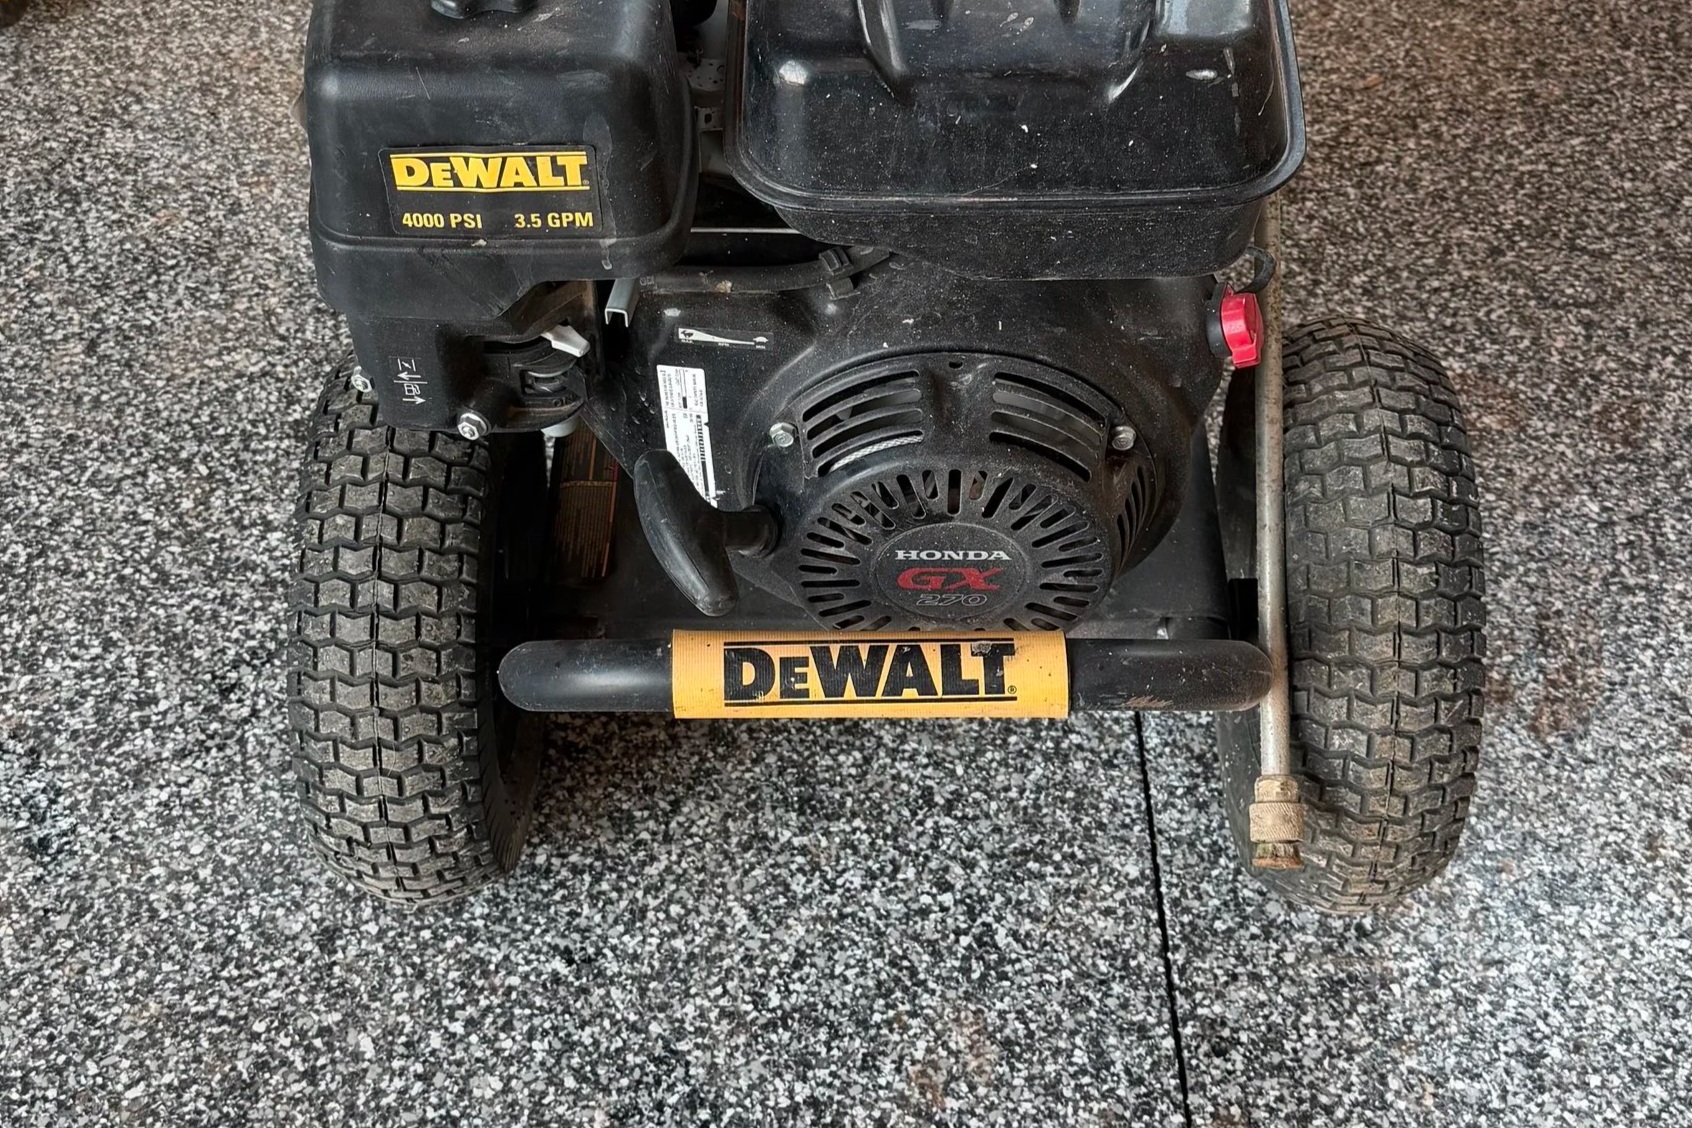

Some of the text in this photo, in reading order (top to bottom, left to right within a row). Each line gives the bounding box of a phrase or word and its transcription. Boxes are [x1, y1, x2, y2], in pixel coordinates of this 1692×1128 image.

[402, 212, 594, 229] 4000 PSI 3.5 GPM
[895, 549, 1012, 561] HONDA
[896, 567, 1001, 590] GX
[916, 593, 988, 606] 270
